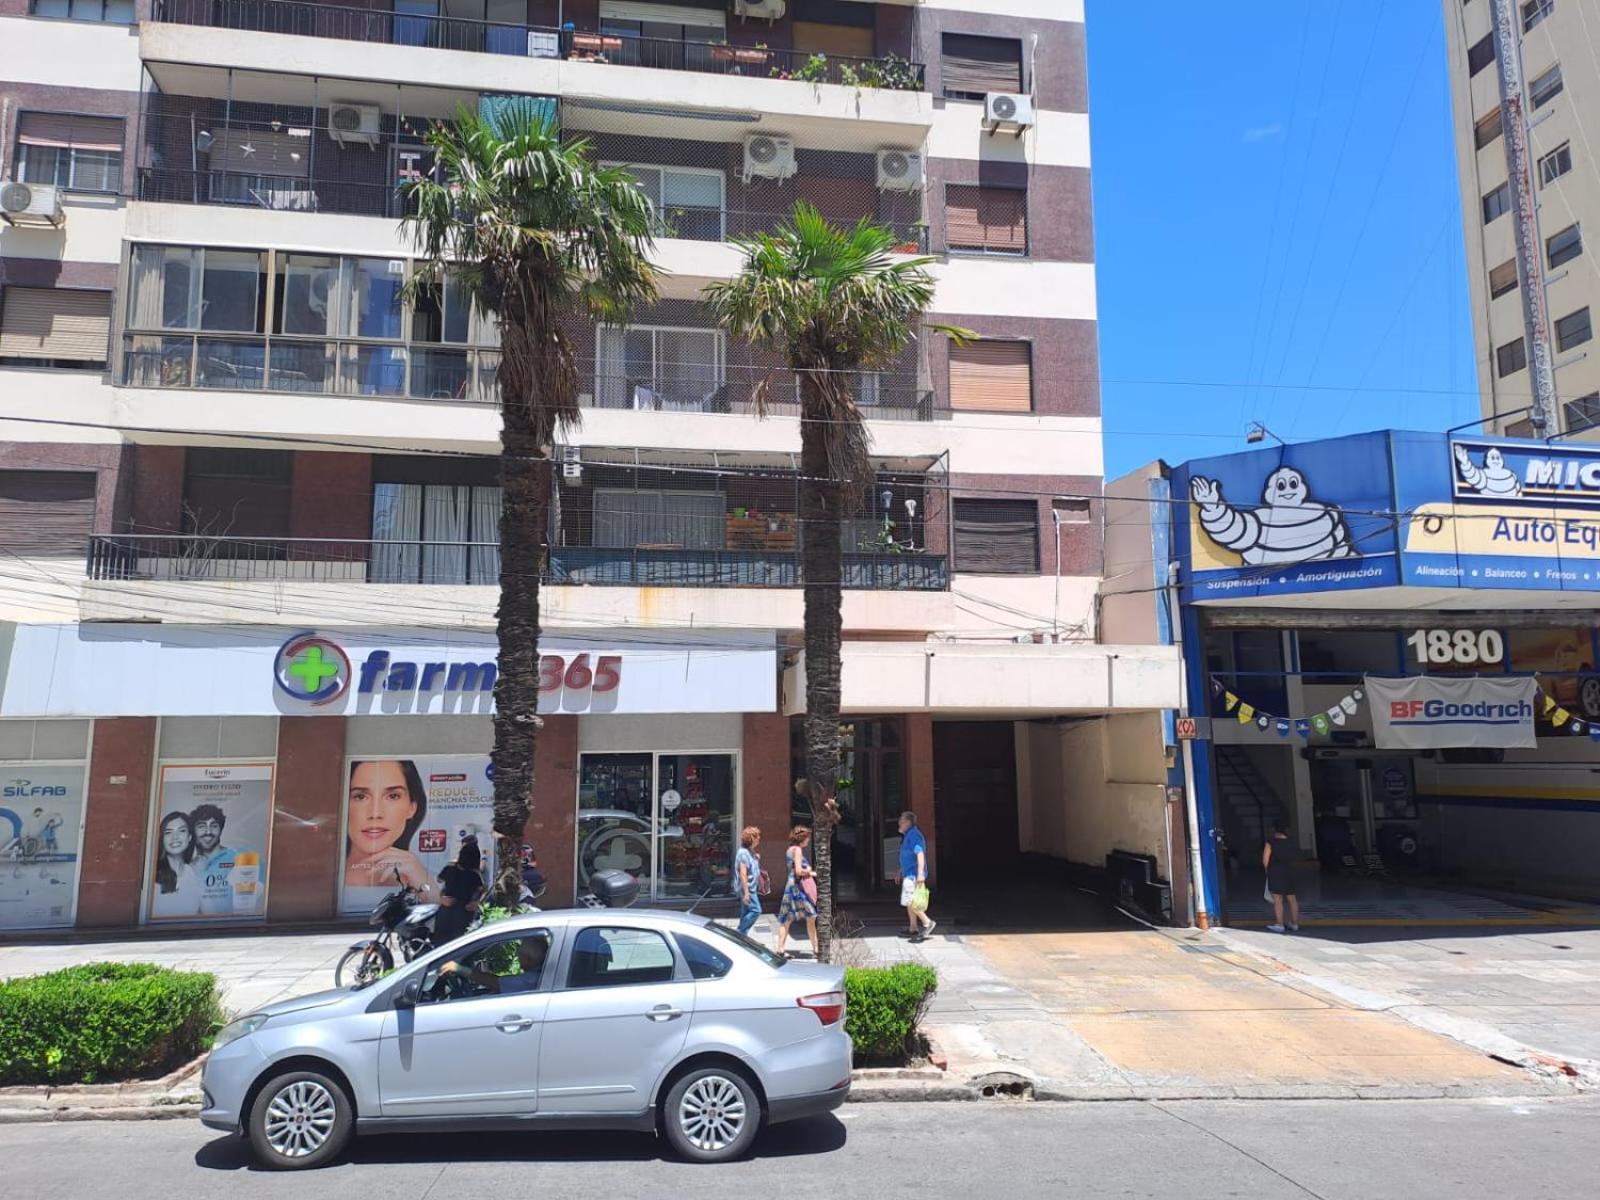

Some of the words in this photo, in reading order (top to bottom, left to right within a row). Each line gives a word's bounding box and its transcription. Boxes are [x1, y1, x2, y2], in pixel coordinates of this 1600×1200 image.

[1492, 516, 1555, 542] Auto
[1564, 518, 1600, 551] Eq
[1207, 576, 1270, 591] Suspensión
[1296, 567, 1383, 584] Amortiguación
[1415, 565, 1465, 577] Alineación
[1484, 567, 1528, 579] Balanceo
[1546, 569, 1577, 580] Frenos
[1407, 629, 1504, 664] 1880
[358, 650, 623, 693] farm365
[1390, 699, 1532, 718] BFGoodrich
[3, 786, 67, 797] SILFAB
[430, 787, 476, 797] REDUCE
[206, 873, 228, 888] 0%
